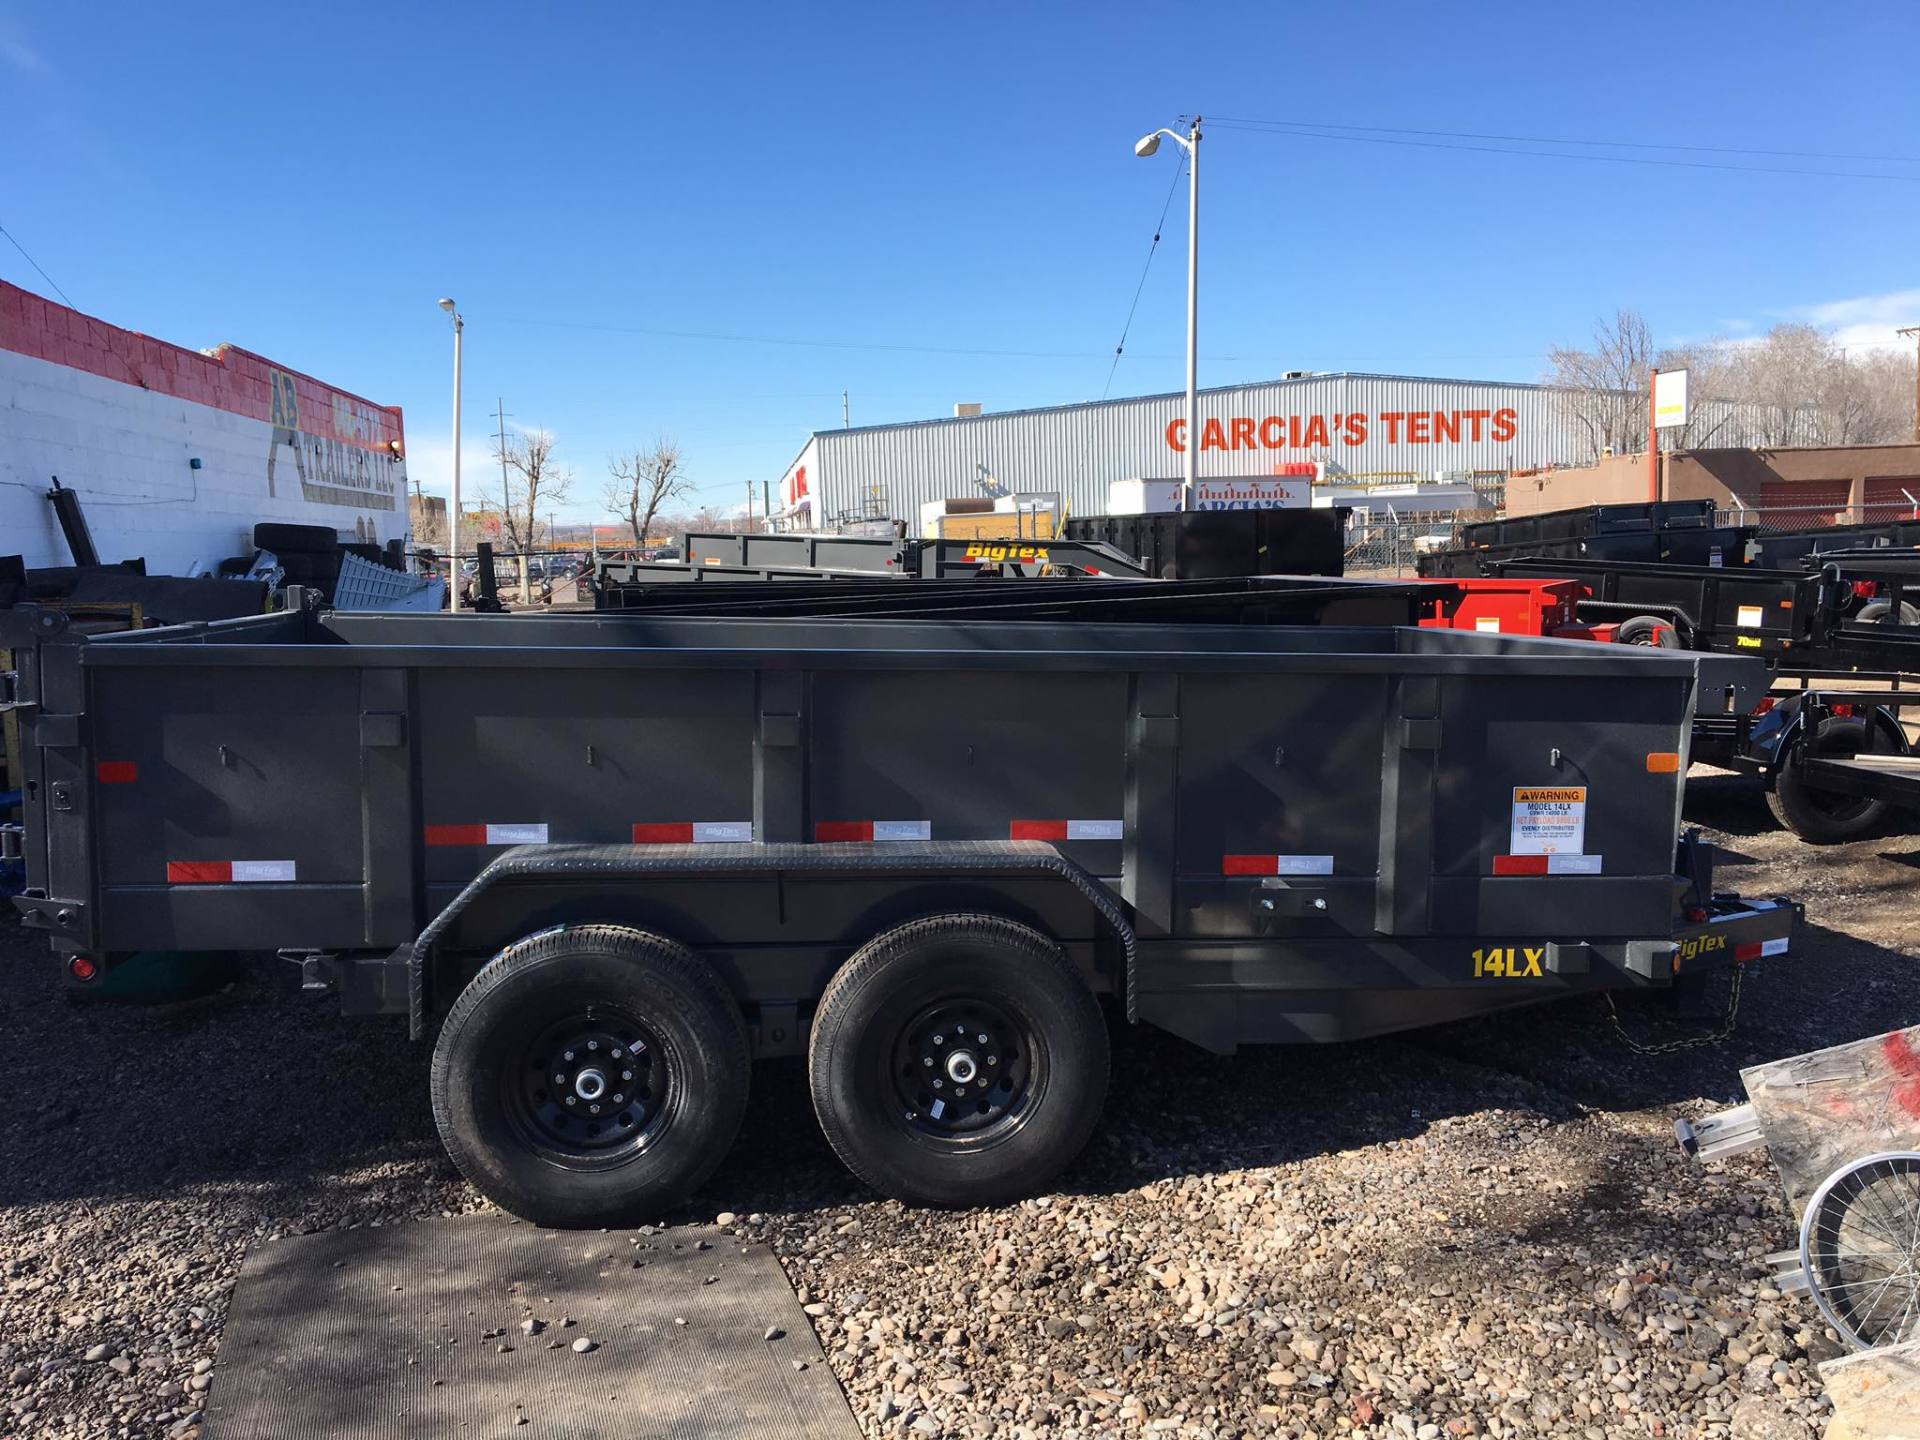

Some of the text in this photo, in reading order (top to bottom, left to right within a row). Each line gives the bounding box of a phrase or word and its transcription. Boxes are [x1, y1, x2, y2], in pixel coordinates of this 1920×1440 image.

[1166, 408, 1517, 452] GARCIA'S TENTS
[304, 432, 370, 489] TRAILERS
[966, 542, 1050, 561] BigTex
[1530, 791, 1579, 800] WARNING
[1472, 948, 1544, 977] 14LX
